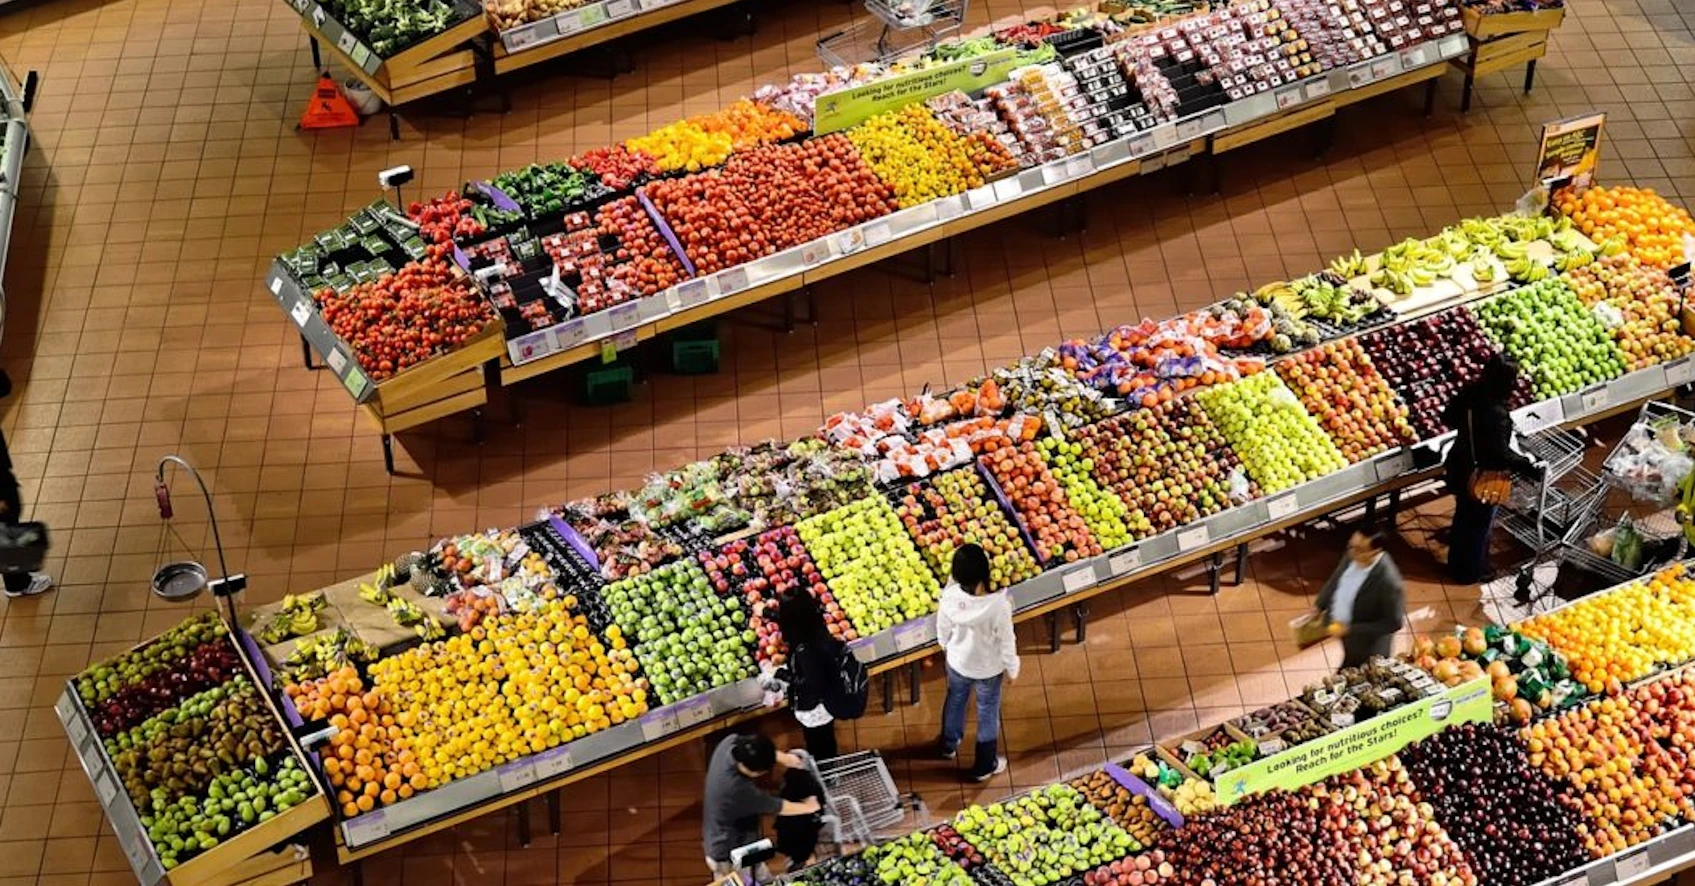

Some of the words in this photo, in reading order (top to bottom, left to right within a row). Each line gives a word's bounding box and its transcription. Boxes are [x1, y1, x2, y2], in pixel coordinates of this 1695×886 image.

[852, 87, 882, 100] Looking
[883, 83, 894, 91] for
[896, 76, 933, 88] nutritious
[934, 64, 967, 79] choices?
[872, 91, 895, 101] Reach
[897, 88, 907, 96] for
[909, 84, 922, 93] the
[924, 78, 947, 89] Stars!
[1266, 753, 1308, 774] Looking
[1310, 746, 1324, 758] for
[1327, 727, 1378, 751] nutritious
[1380, 708, 1424, 731] choices?
[1295, 756, 1328, 774] Reach
[1329, 749, 1344, 761] for
[1347, 743, 1364, 754] the
[1366, 728, 1397, 747] Stars!
